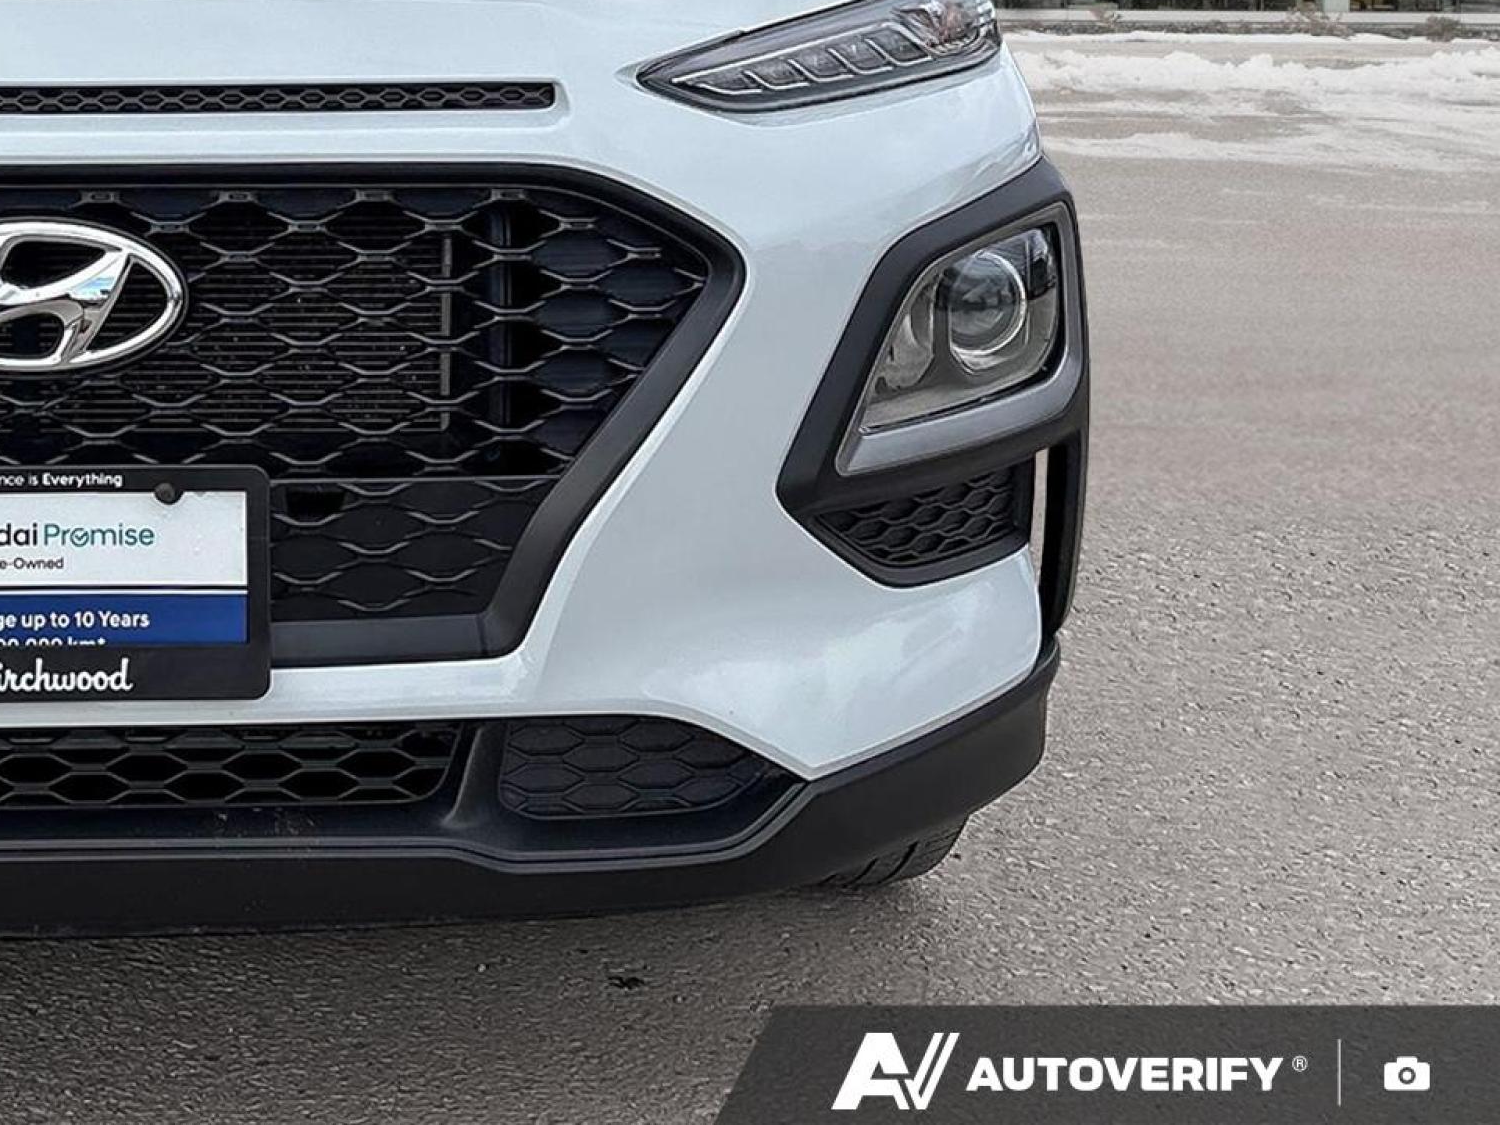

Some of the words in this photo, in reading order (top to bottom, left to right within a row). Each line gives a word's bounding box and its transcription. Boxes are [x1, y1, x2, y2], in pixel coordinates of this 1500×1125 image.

[29, 473, 38, 486] is
[42, 472, 122, 488] Everything
[43, 524, 155, 547] Promise
[21, 615, 46, 631] up
[51, 613, 70, 627] to
[74, 611, 95, 627] 10
[99, 611, 150, 627] Years
